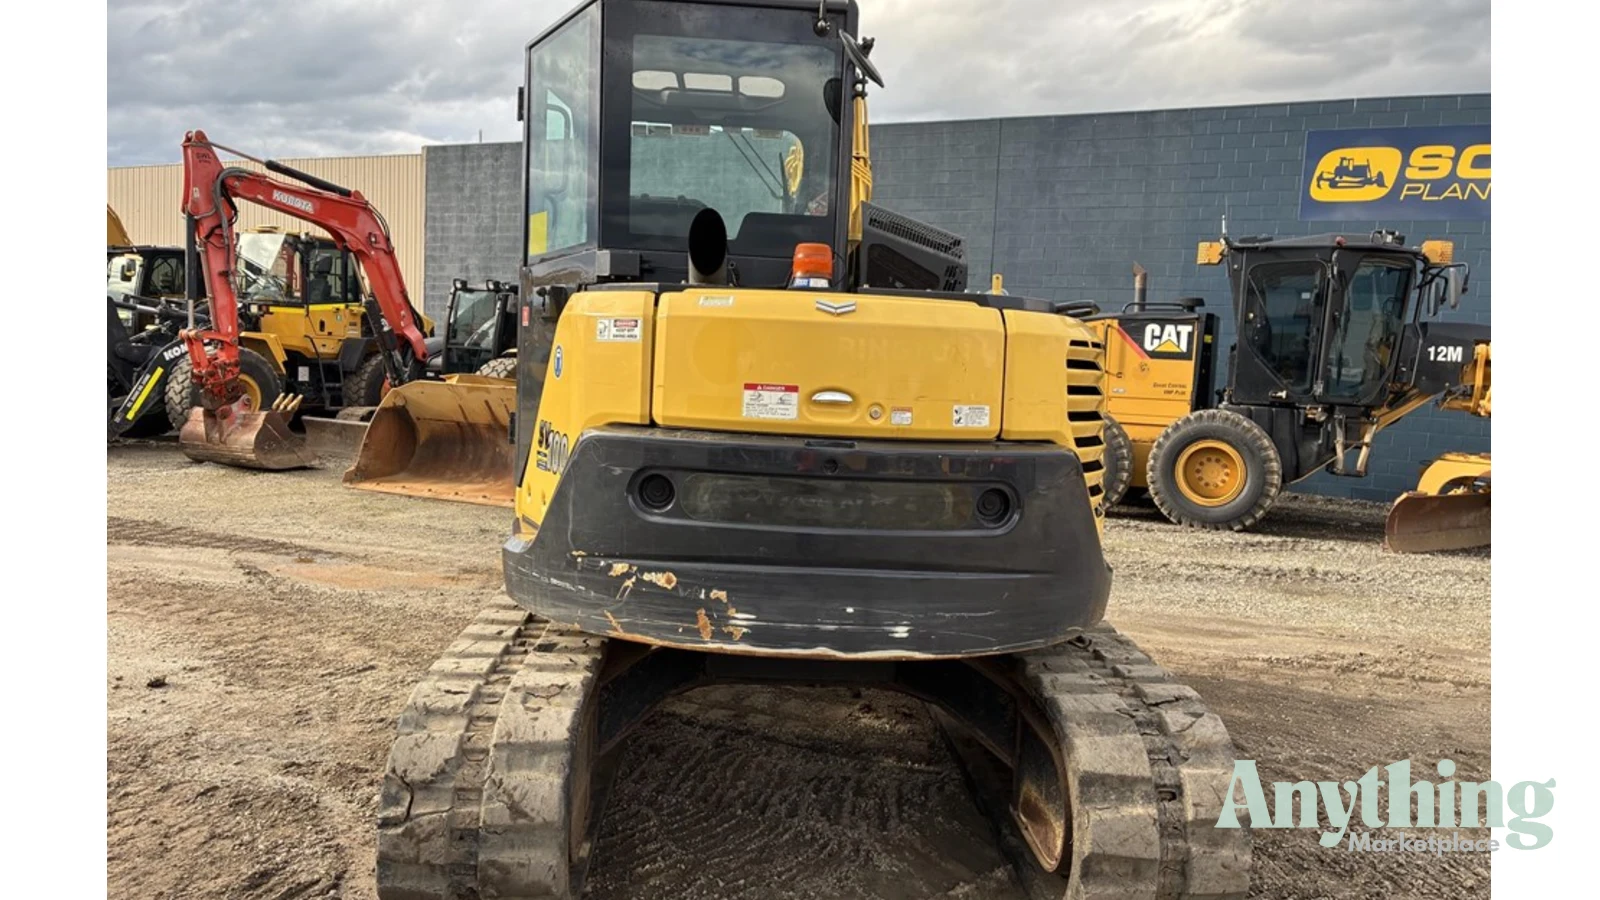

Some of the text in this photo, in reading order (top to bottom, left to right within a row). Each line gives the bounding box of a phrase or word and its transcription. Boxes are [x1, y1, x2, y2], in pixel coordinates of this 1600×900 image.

[272, 189, 314, 214] KUBOTA
[1400, 182, 1491, 200] PLAN
[1144, 323, 1193, 353] CAT
[1427, 345, 1463, 362] 12M
